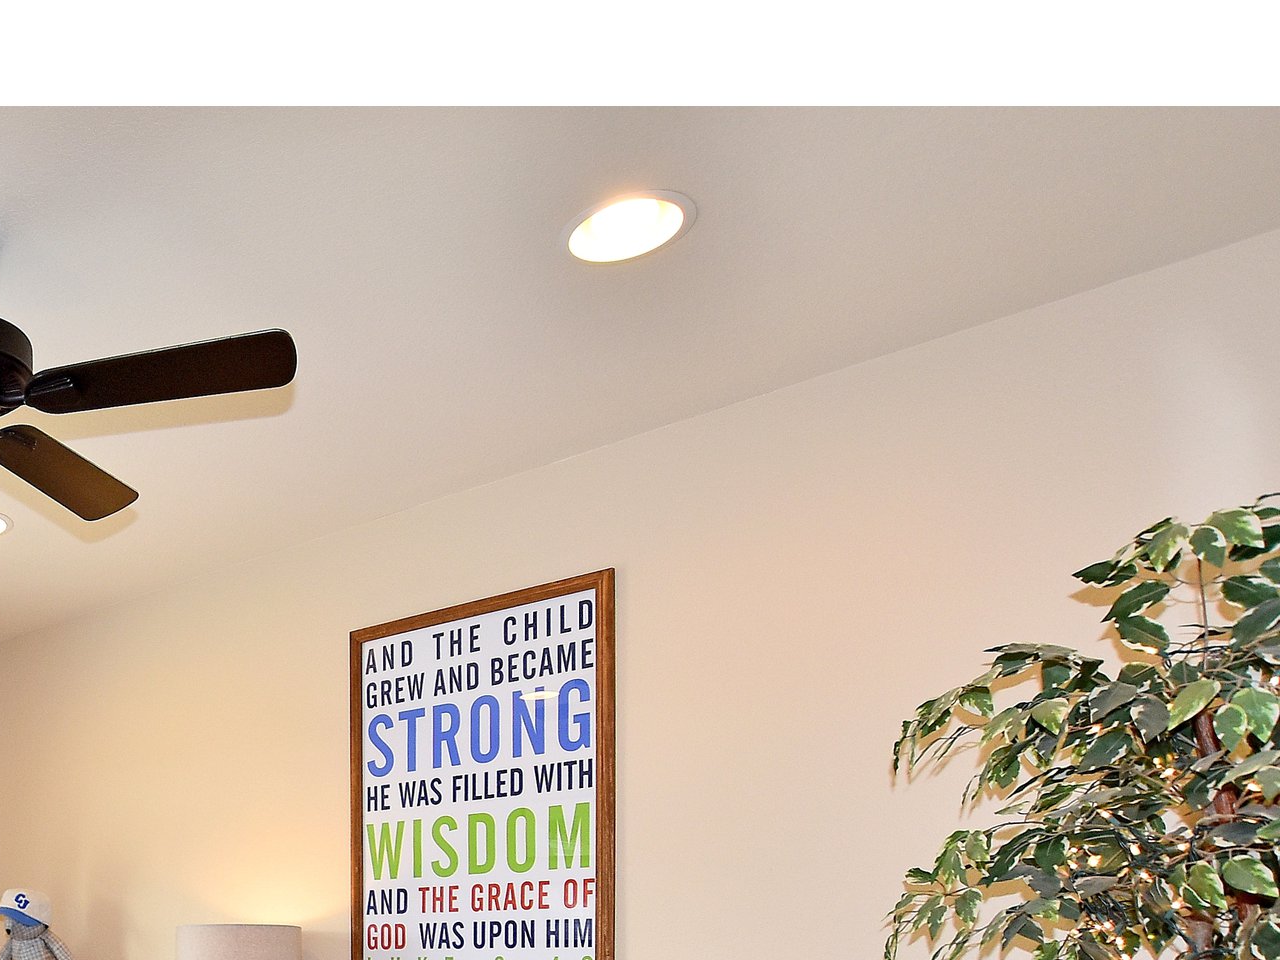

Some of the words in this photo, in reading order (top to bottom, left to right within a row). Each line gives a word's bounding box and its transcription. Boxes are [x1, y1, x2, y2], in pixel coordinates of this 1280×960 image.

[366, 641, 413, 675] AND
[433, 624, 480, 660] THE
[503, 599, 594, 646] CHILD
[366, 672, 425, 709] GREW
[434, 662, 479, 697] AND
[491, 638, 594, 683] BECAME
[367, 678, 592, 778] STRONG
[367, 784, 390, 812] HE
[398, 777, 443, 809] WAS
[453, 767, 524, 803] FILLED
[534, 758, 594, 794] WITH
[367, 802, 591, 881] WISDOM
[367, 887, 408, 916] AND
[418, 884, 459, 914] THE
[471, 879, 550, 912] GRACE
[563, 877, 595, 909] OF
[367, 923, 407, 950] GOD
[420, 920, 465, 949] WAS
[473, 919, 536, 949] UPON
[545, 918, 593, 948] HIM
